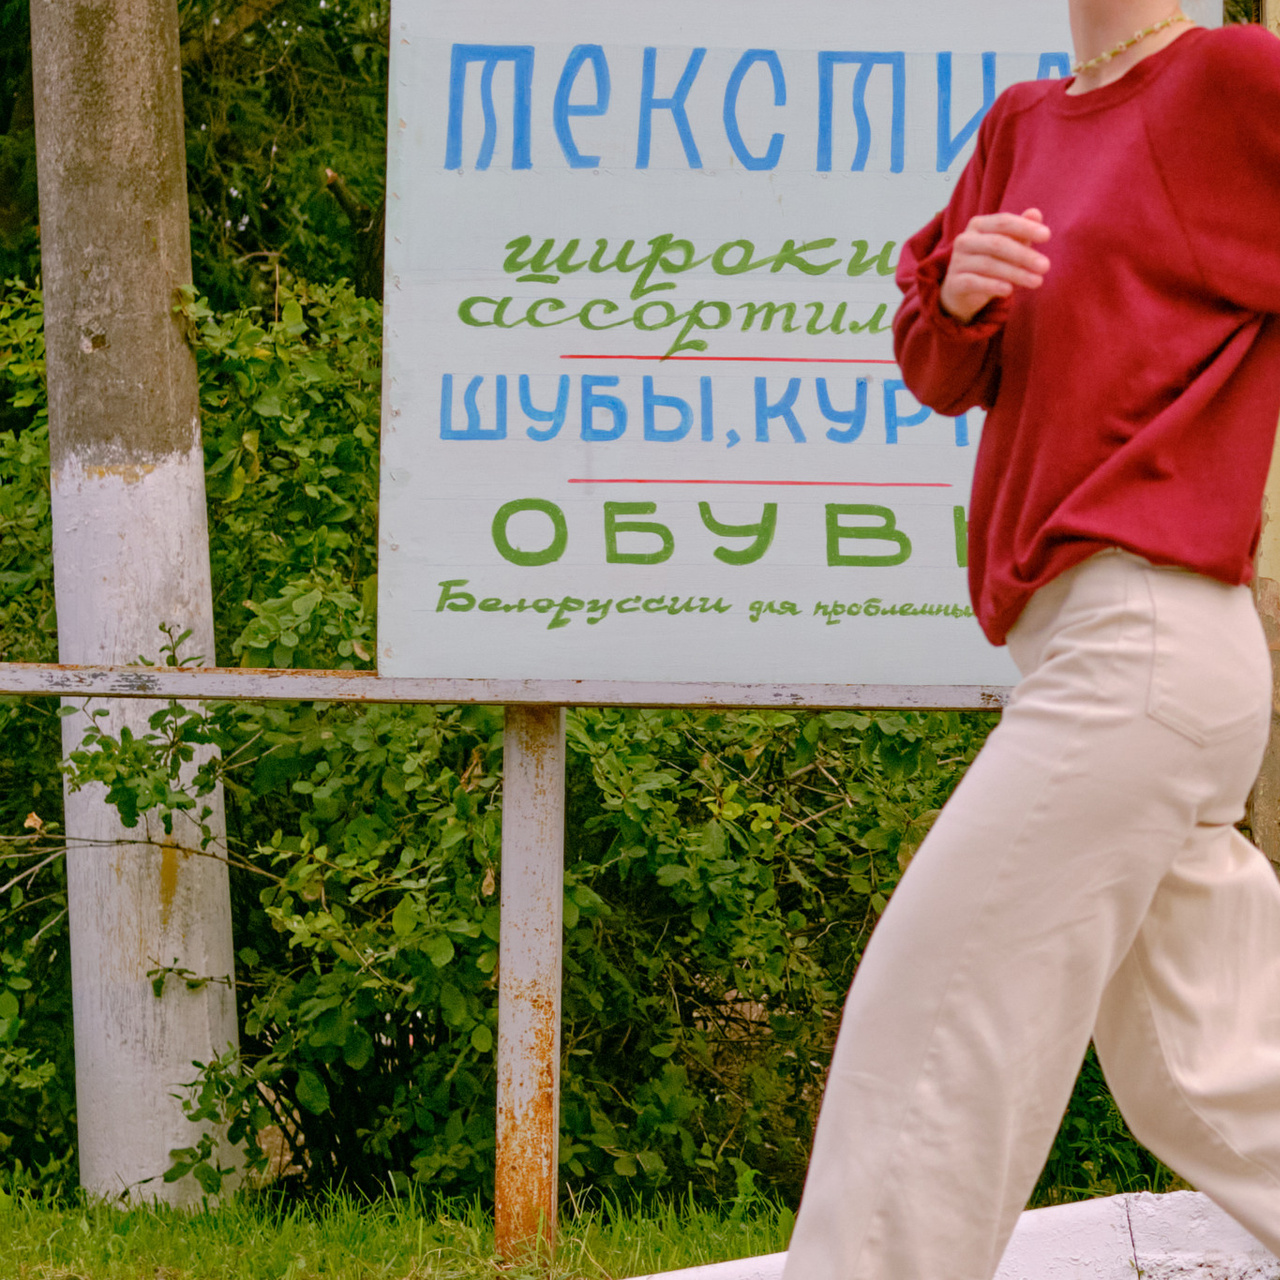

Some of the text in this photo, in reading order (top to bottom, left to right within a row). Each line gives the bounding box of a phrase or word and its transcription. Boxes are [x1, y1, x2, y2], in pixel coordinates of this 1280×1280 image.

[443, 43, 1073, 174] ТЕКСТИ
[502, 232, 898, 304] широки
[435, 579, 733, 631] Белоруссии
[748, 599, 803, 623] для
